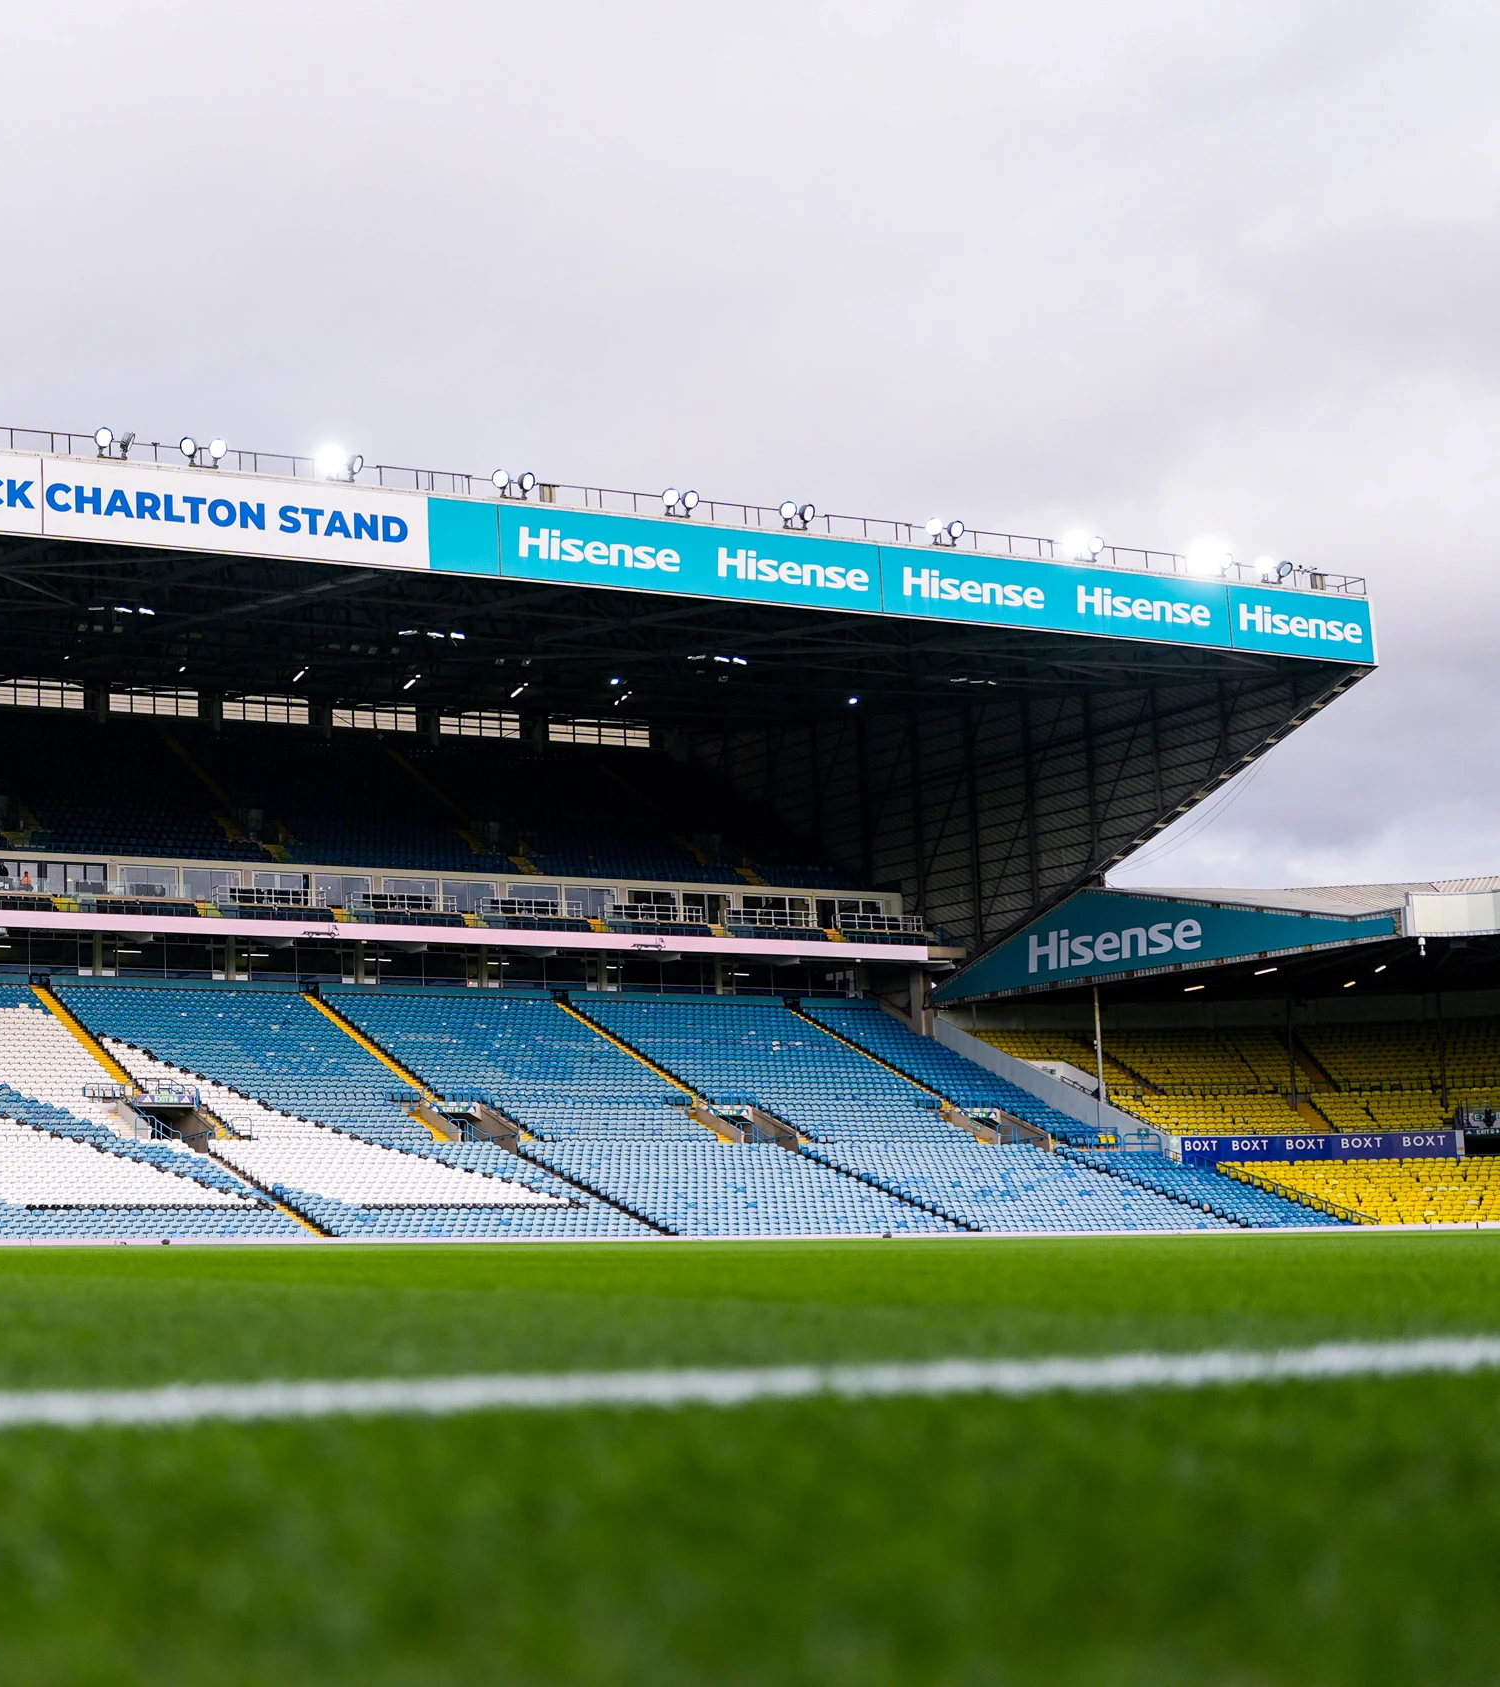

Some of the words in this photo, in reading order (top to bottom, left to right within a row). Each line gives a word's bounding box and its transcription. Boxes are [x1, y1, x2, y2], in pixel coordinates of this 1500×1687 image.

[46, 483, 266, 531] CHARLTON
[279, 505, 409, 543] STAND
[519, 527, 681, 573] Hisense
[718, 547, 870, 592] Hisense
[904, 567, 1045, 610] Hisense
[1078, 586, 1211, 627] Hisense
[1240, 604, 1363, 644] Hisense
[1028, 918, 1202, 973] Hisense
[1184, 1140, 1218, 1152] BOXT
[1231, 1139, 1269, 1151] BOXT
[1285, 1138, 1325, 1150] BOXT
[1341, 1137, 1383, 1149] BOXT
[1402, 1135, 1446, 1147] BOXT
